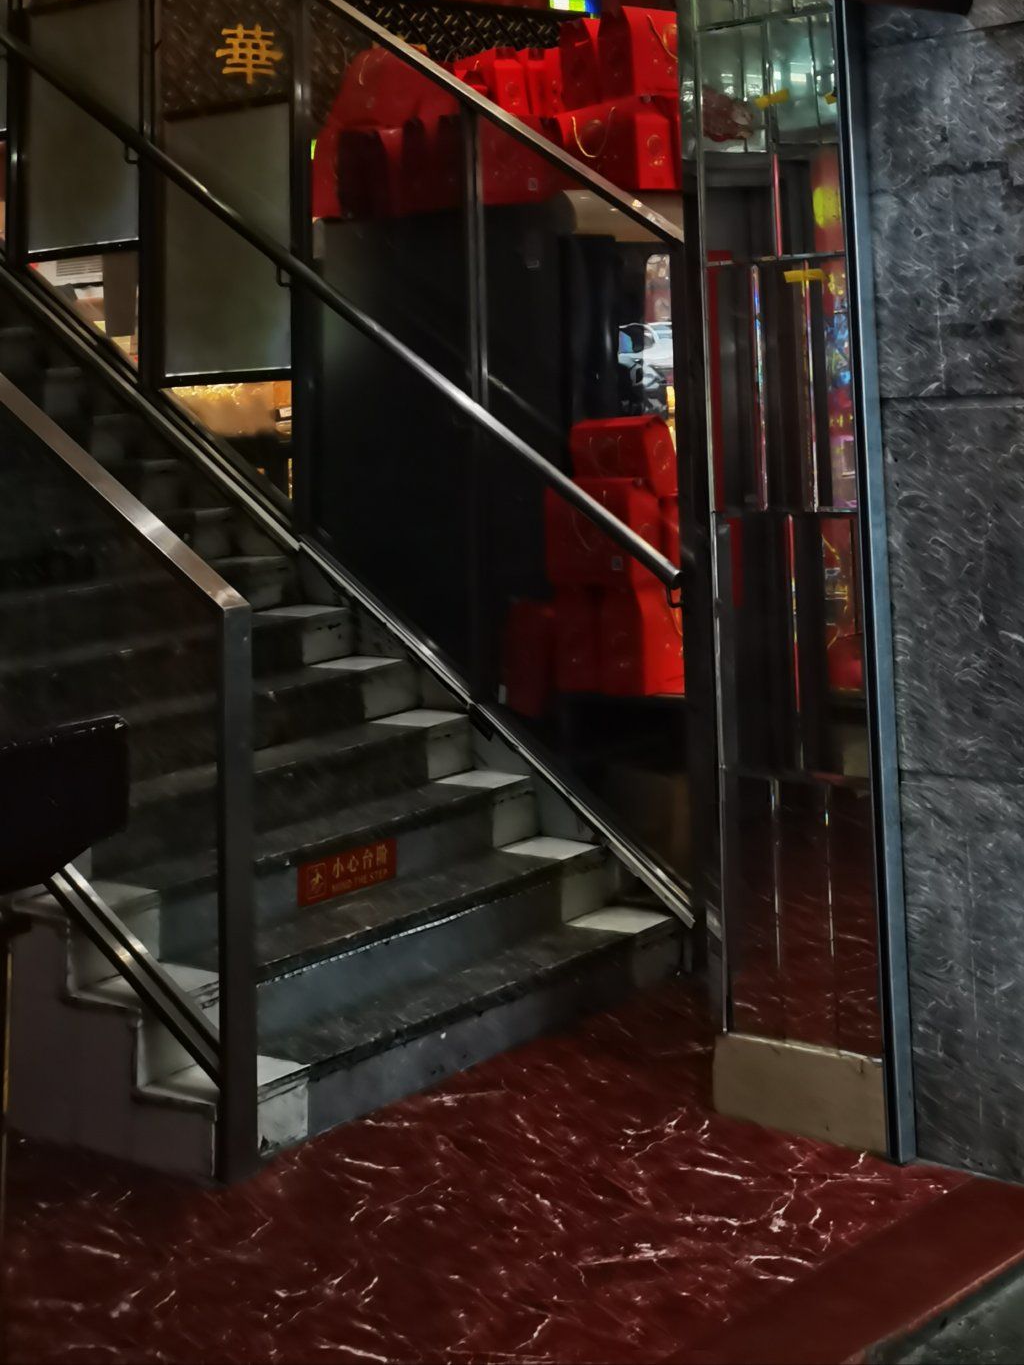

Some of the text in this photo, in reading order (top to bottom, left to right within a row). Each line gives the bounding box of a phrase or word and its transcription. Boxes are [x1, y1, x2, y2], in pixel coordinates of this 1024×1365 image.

[215, 23, 283, 84] 華
[332, 845, 388, 879] 小心台阶
